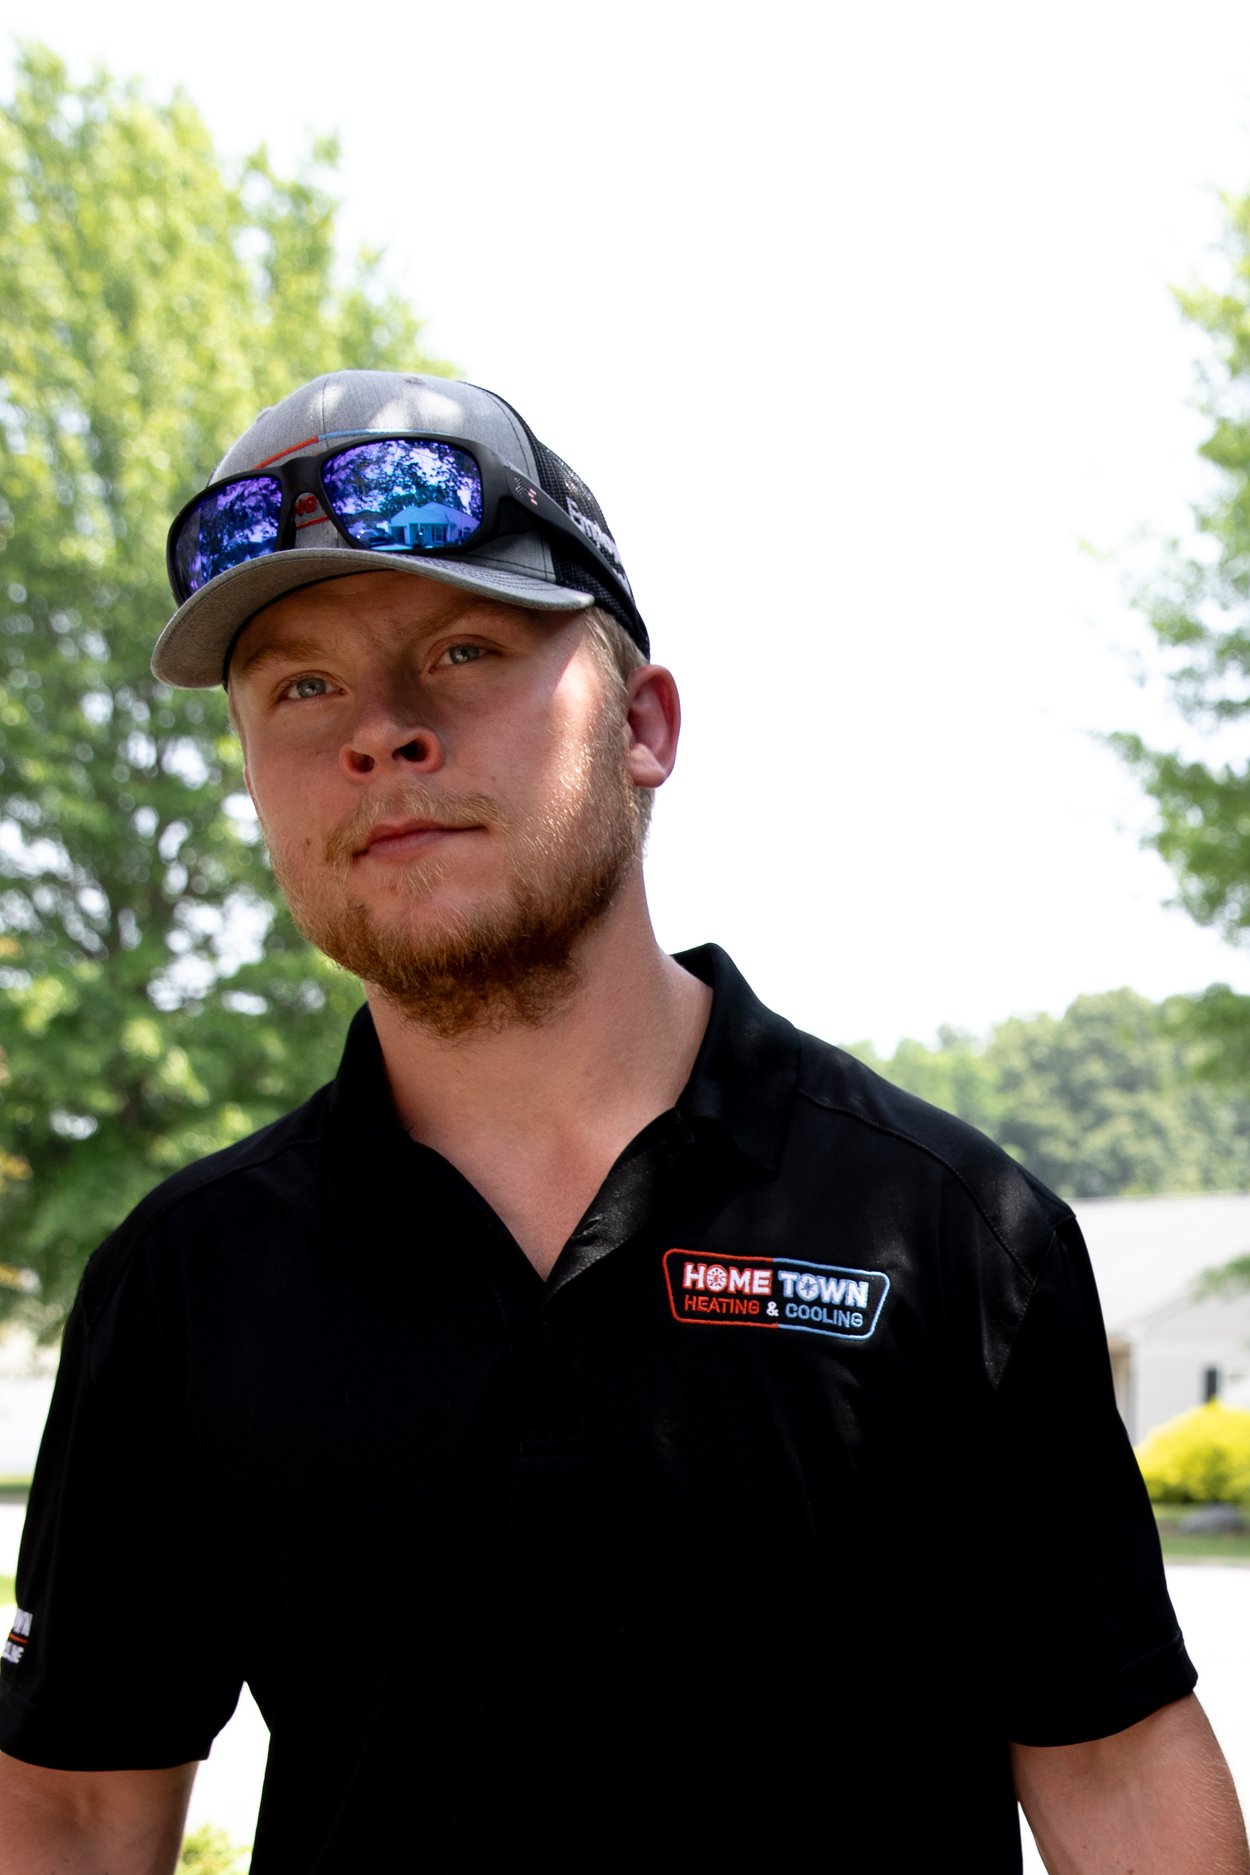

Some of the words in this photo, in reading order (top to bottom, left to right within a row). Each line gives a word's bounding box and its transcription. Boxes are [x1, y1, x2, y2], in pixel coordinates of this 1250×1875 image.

[682, 1262, 773, 1296] HOME
[777, 1270, 869, 1309] TOWN
[683, 1295, 760, 1315] HEATING
[766, 1301, 779, 1317] &
[785, 1303, 864, 1327] COOLING
